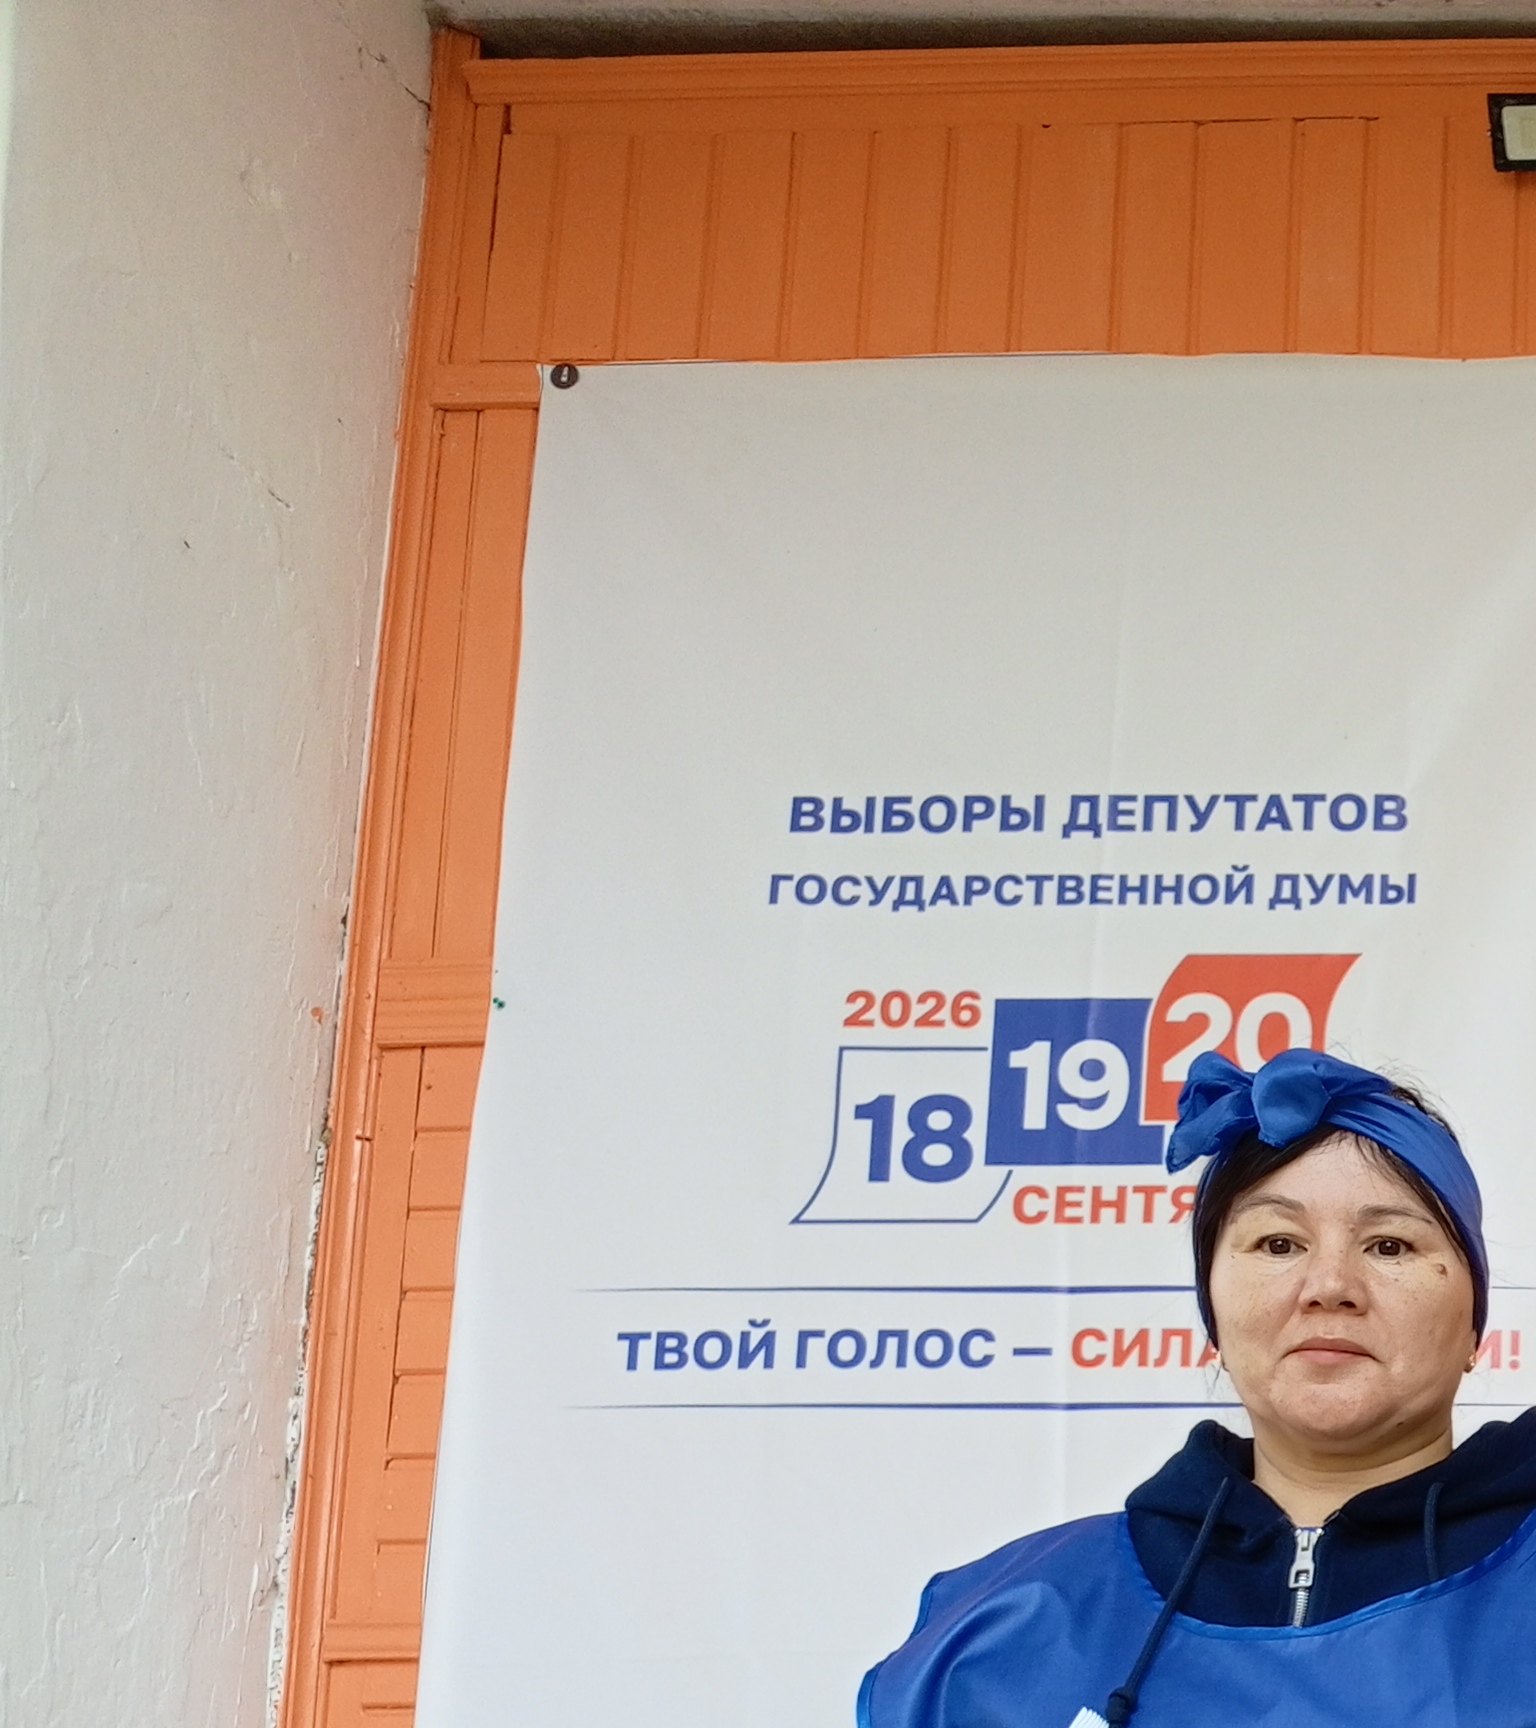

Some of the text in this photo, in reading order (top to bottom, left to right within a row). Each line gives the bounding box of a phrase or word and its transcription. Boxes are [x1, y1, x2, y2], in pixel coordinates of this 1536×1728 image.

[789, 793, 1408, 839] ВЫБОРЫ ДЕПУТАТОВ
[768, 865, 1417, 912] ГОСУДАРСТВЕННОЙ ДУМЫ
[843, 990, 982, 1029] 2026
[853, 991, 1313, 1184] 18 19 20
[1012, 1184, 1199, 1226] СЕНТЯ
[617, 1318, 777, 1372] ТВОЙ
[795, 1328, 996, 1370] ГОЛОС
